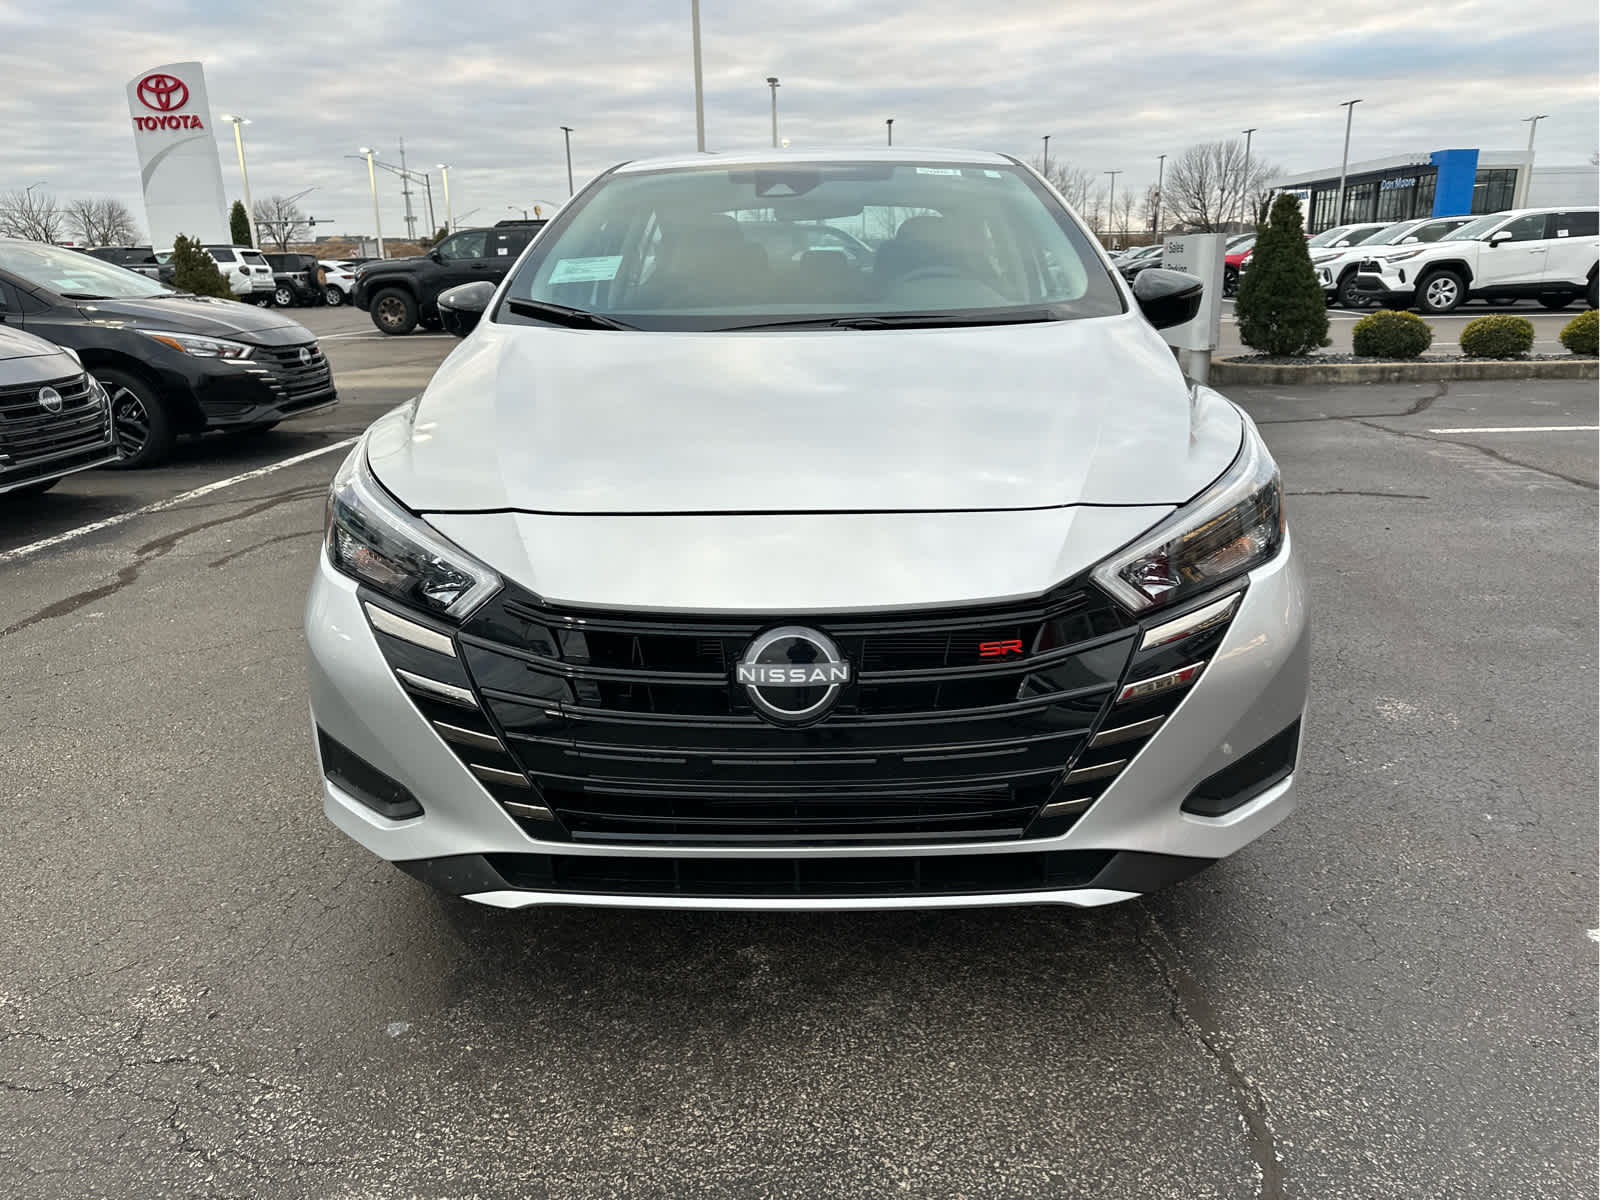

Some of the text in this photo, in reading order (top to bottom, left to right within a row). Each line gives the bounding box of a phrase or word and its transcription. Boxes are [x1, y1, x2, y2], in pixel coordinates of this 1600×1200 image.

[133, 115, 204, 131] TOYOTA
[979, 639, 1023, 656] SR
[739, 666, 847, 683] NISSAN
